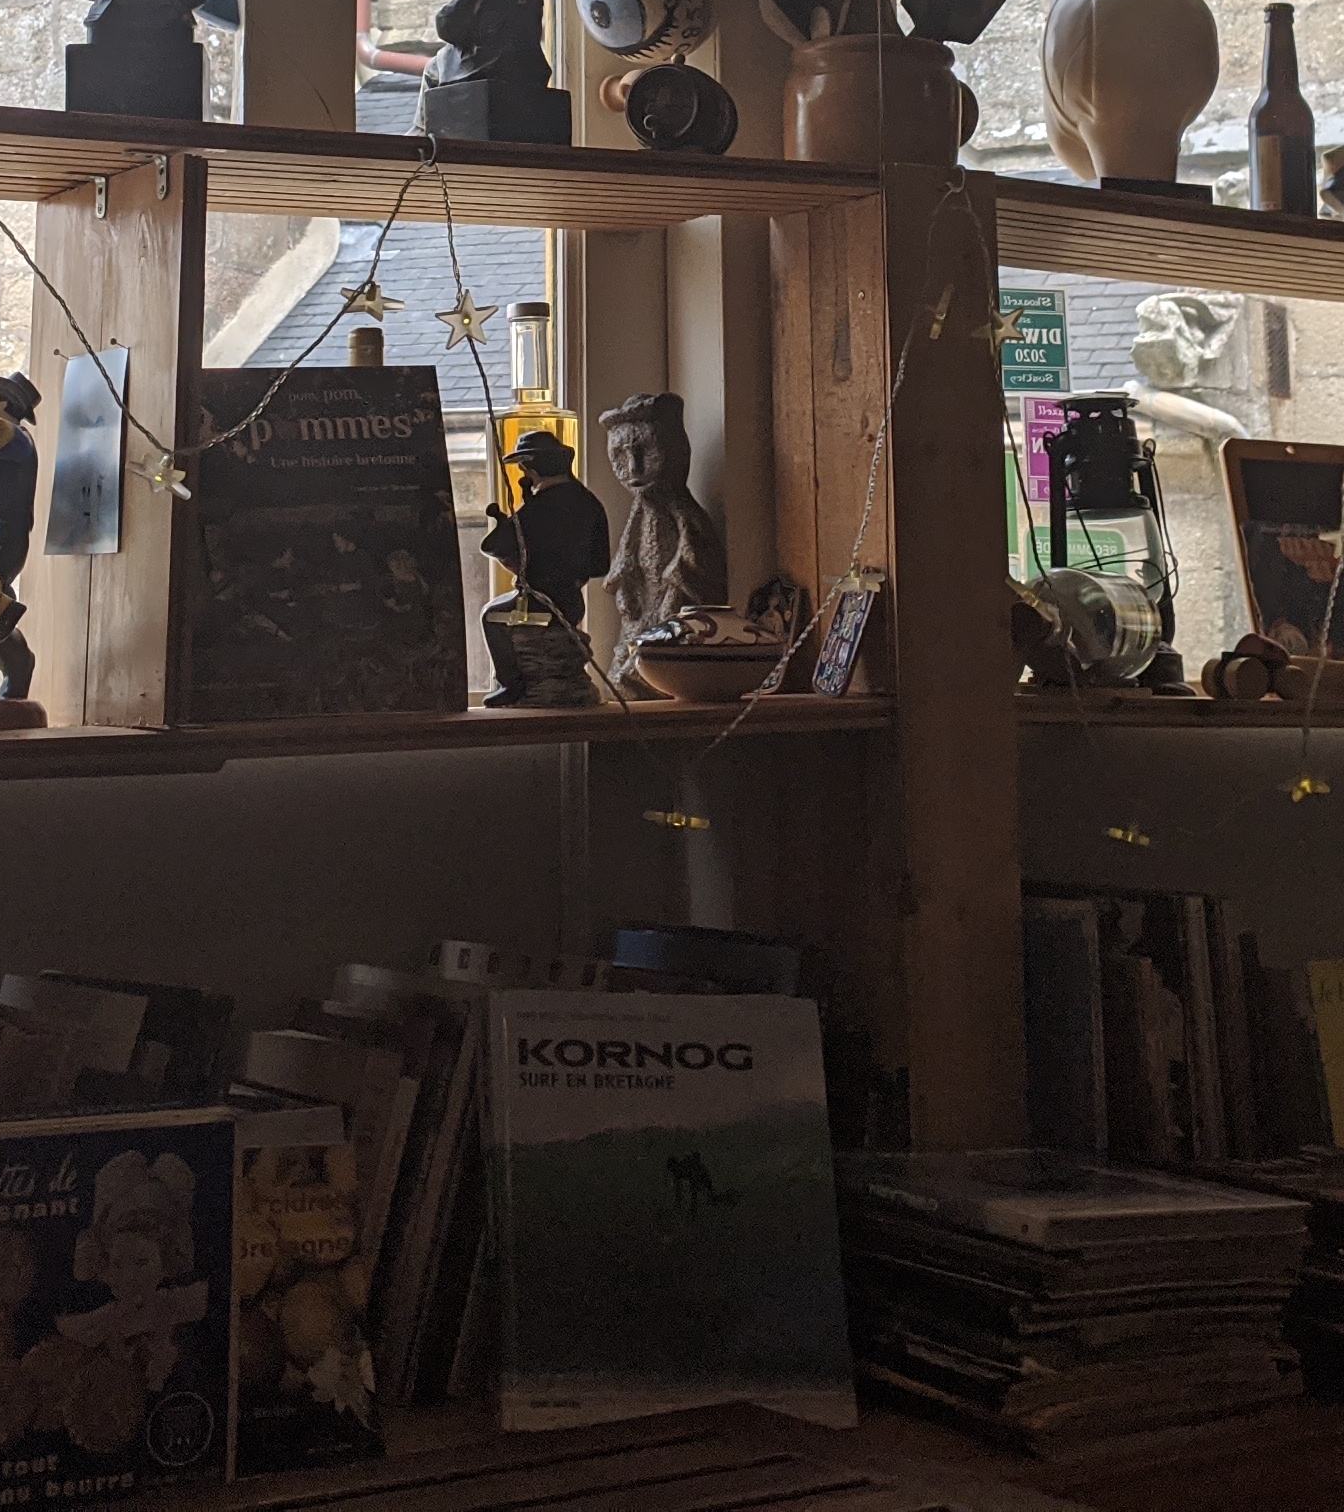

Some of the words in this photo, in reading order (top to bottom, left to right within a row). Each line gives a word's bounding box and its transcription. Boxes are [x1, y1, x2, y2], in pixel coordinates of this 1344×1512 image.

[249, 410, 414, 451] pmmes
[355, 452, 417, 467] bretonne
[517, 1036, 754, 1071] KORNOG
[518, 1072, 559, 1088] SURF
[566, 1072, 587, 1088] EN
[593, 1073, 677, 1090] BRETAGNE
[47, 1151, 79, 1193] de
[0, 1452, 60, 1479] tout
[44, 1469, 135, 1500] beurre
